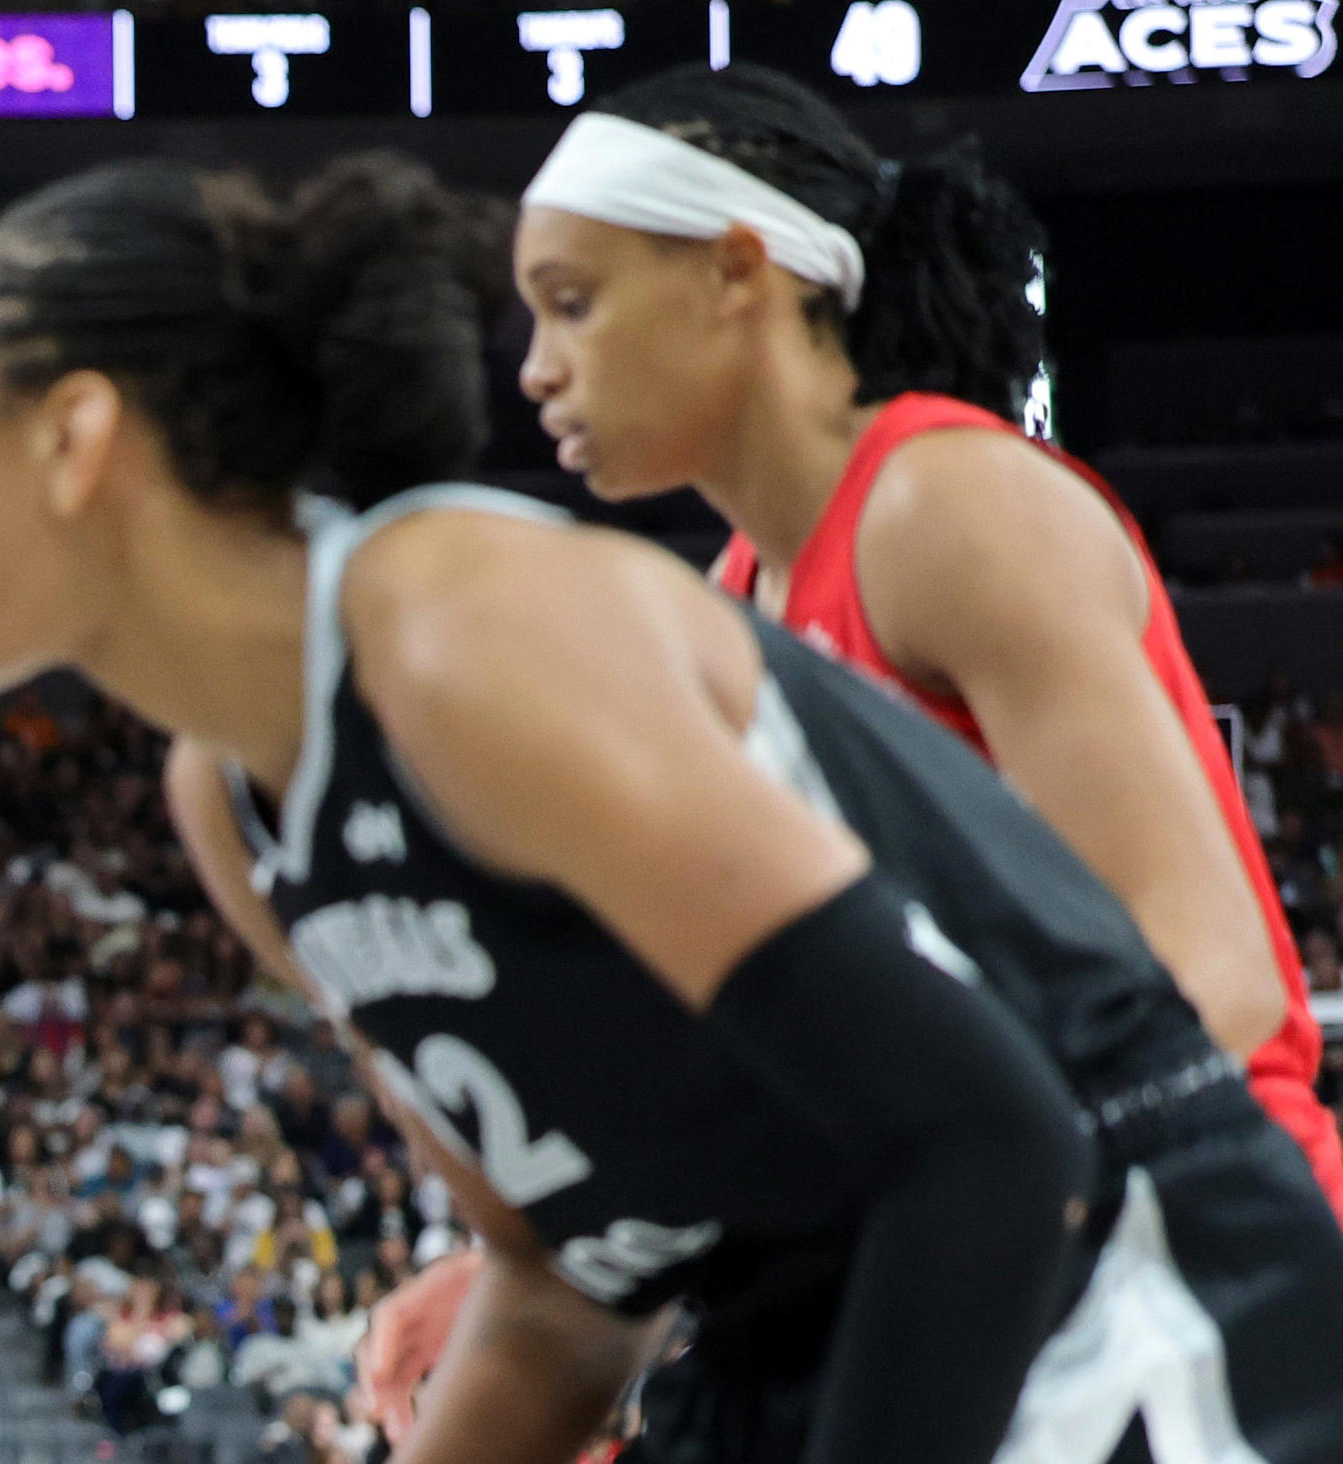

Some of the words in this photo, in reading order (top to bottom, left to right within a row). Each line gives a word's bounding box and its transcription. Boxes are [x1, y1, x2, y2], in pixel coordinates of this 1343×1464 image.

[1053, 3, 1319, 72] ACES
[252, 48, 289, 107] 3
[547, 48, 584, 106] 3
